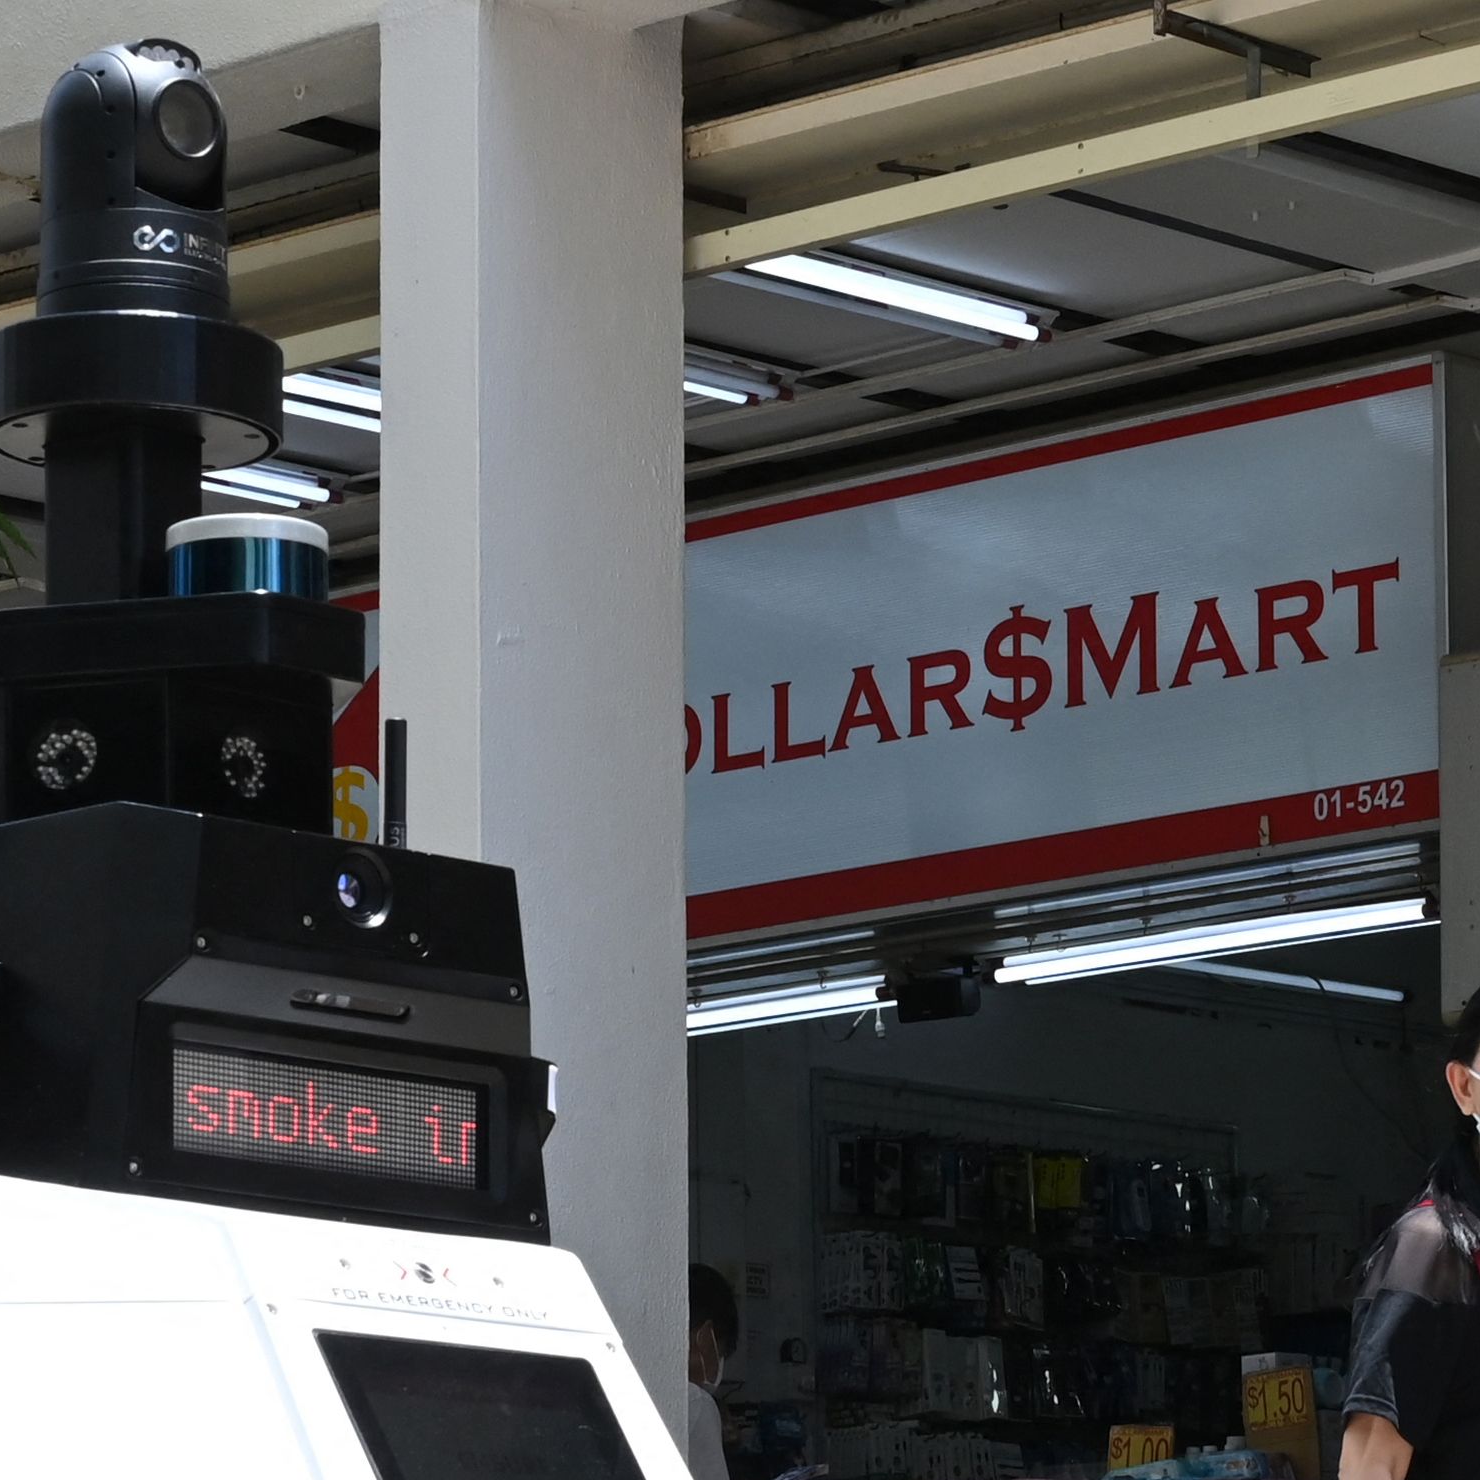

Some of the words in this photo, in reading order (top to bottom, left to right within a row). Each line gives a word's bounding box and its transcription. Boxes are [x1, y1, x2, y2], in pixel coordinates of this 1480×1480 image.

[1313, 779, 1406, 822] 01-542
[185, 1081, 379, 1157] smoke
[332, 1287, 369, 1301] FOR
[377, 1291, 494, 1315] EMERGENCY
[502, 1306, 549, 1321] ONLY
[1247, 1377, 1305, 1422] $1.50
